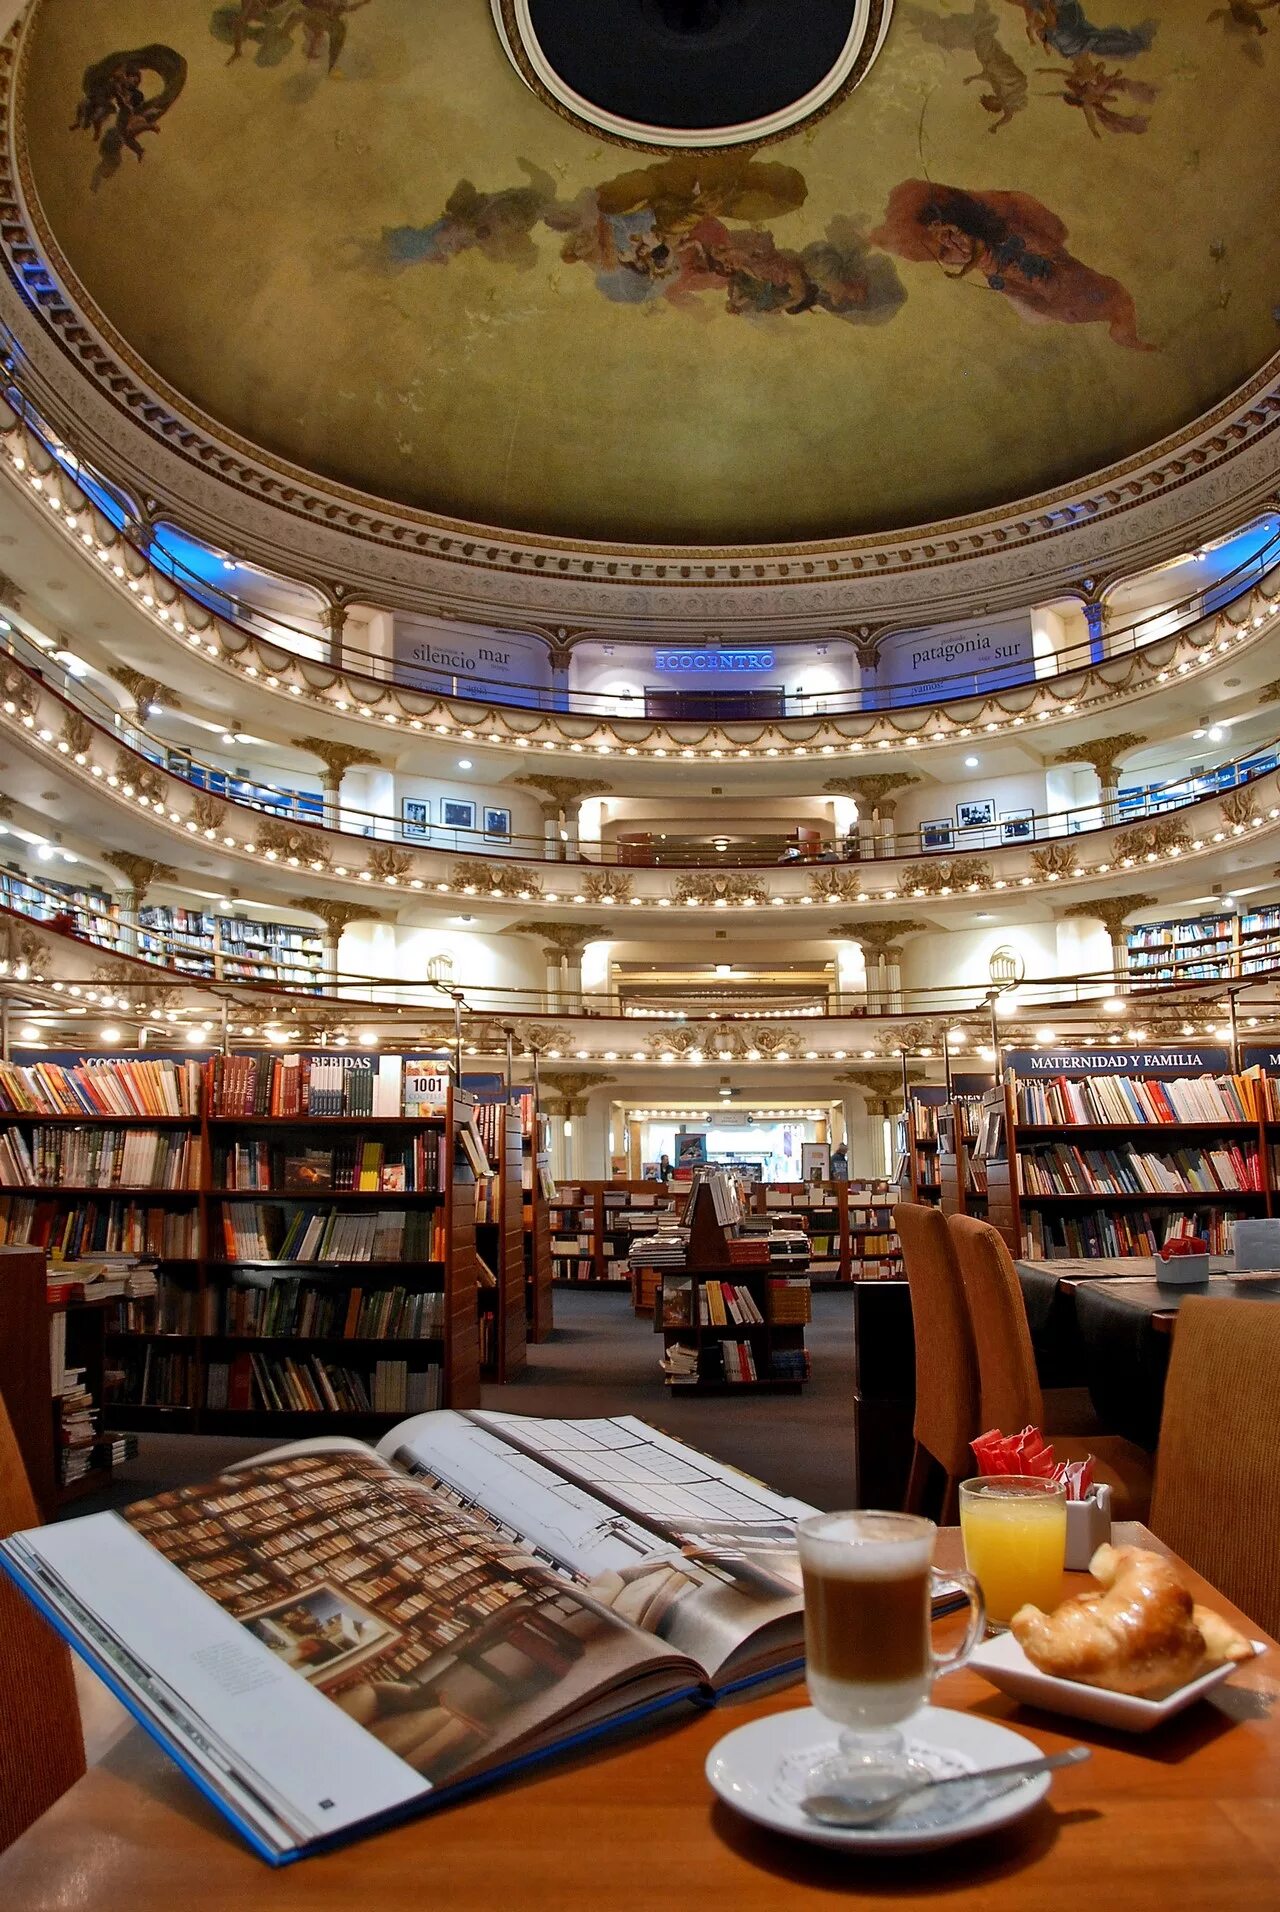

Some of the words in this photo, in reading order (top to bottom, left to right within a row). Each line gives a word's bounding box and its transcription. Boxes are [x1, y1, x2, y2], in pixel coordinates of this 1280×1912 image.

[413, 644, 476, 670] silencio
[478, 648, 511, 664] mar
[912, 633, 990, 669] patagonia
[994, 643, 1021, 659] sur
[655, 655, 774, 668] ECOCENTRO
[86, 1057, 139, 1067] COCI
[311, 1056, 371, 1069] BEBIDAS
[1031, 1055, 1127, 1069] MATERNIDAD
[1129, 1055, 1140, 1067] Y
[1143, 1054, 1204, 1067] FAMILIA
[413, 1078, 442, 1092] 1001
